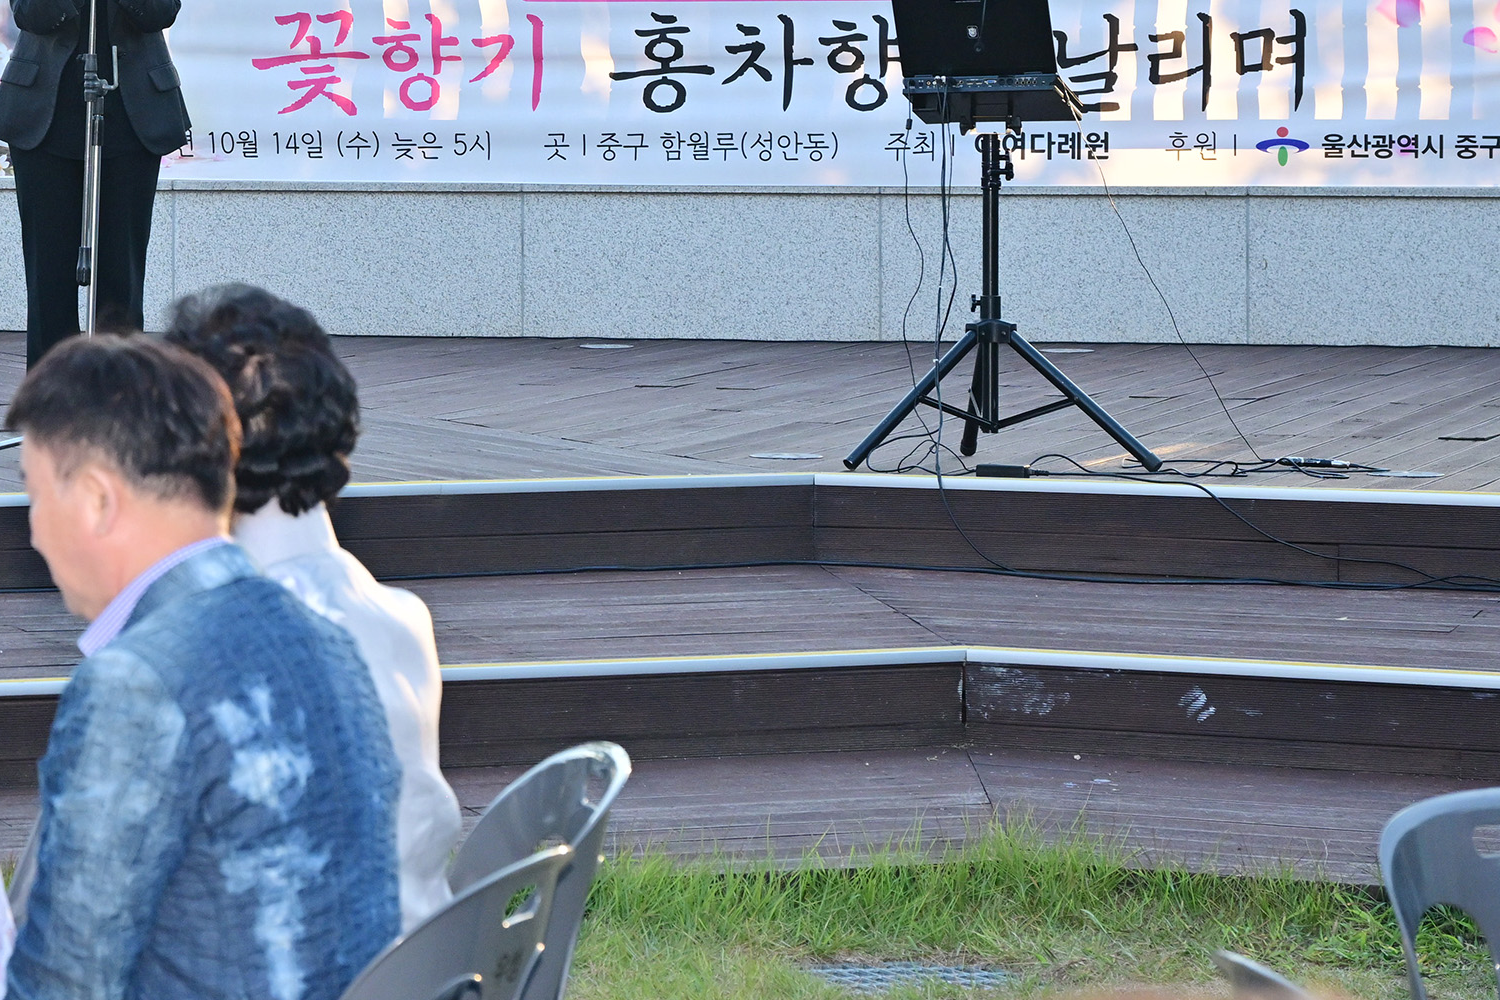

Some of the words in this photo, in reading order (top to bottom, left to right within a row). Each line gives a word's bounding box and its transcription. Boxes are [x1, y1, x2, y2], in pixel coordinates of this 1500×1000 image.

[252, 9, 544, 116] 꽃향기
[609, 11, 900, 113] 홍차향
[1053, 8, 1307, 112] 날리며
[208, 129, 259, 158] 10월
[272, 130, 323, 159] 14일
[337, 130, 380, 160] (수)
[391, 132, 443, 160] 늦은
[453, 130, 492, 161] 5시
[543, 133, 570, 161] 곳
[596, 132, 649, 162] 중구
[884, 130, 935, 162] 주최
[1165, 130, 1218, 162] 후원
[1321, 133, 1445, 160] 울산광역시
[1454, 134, 1500, 160] 중구
